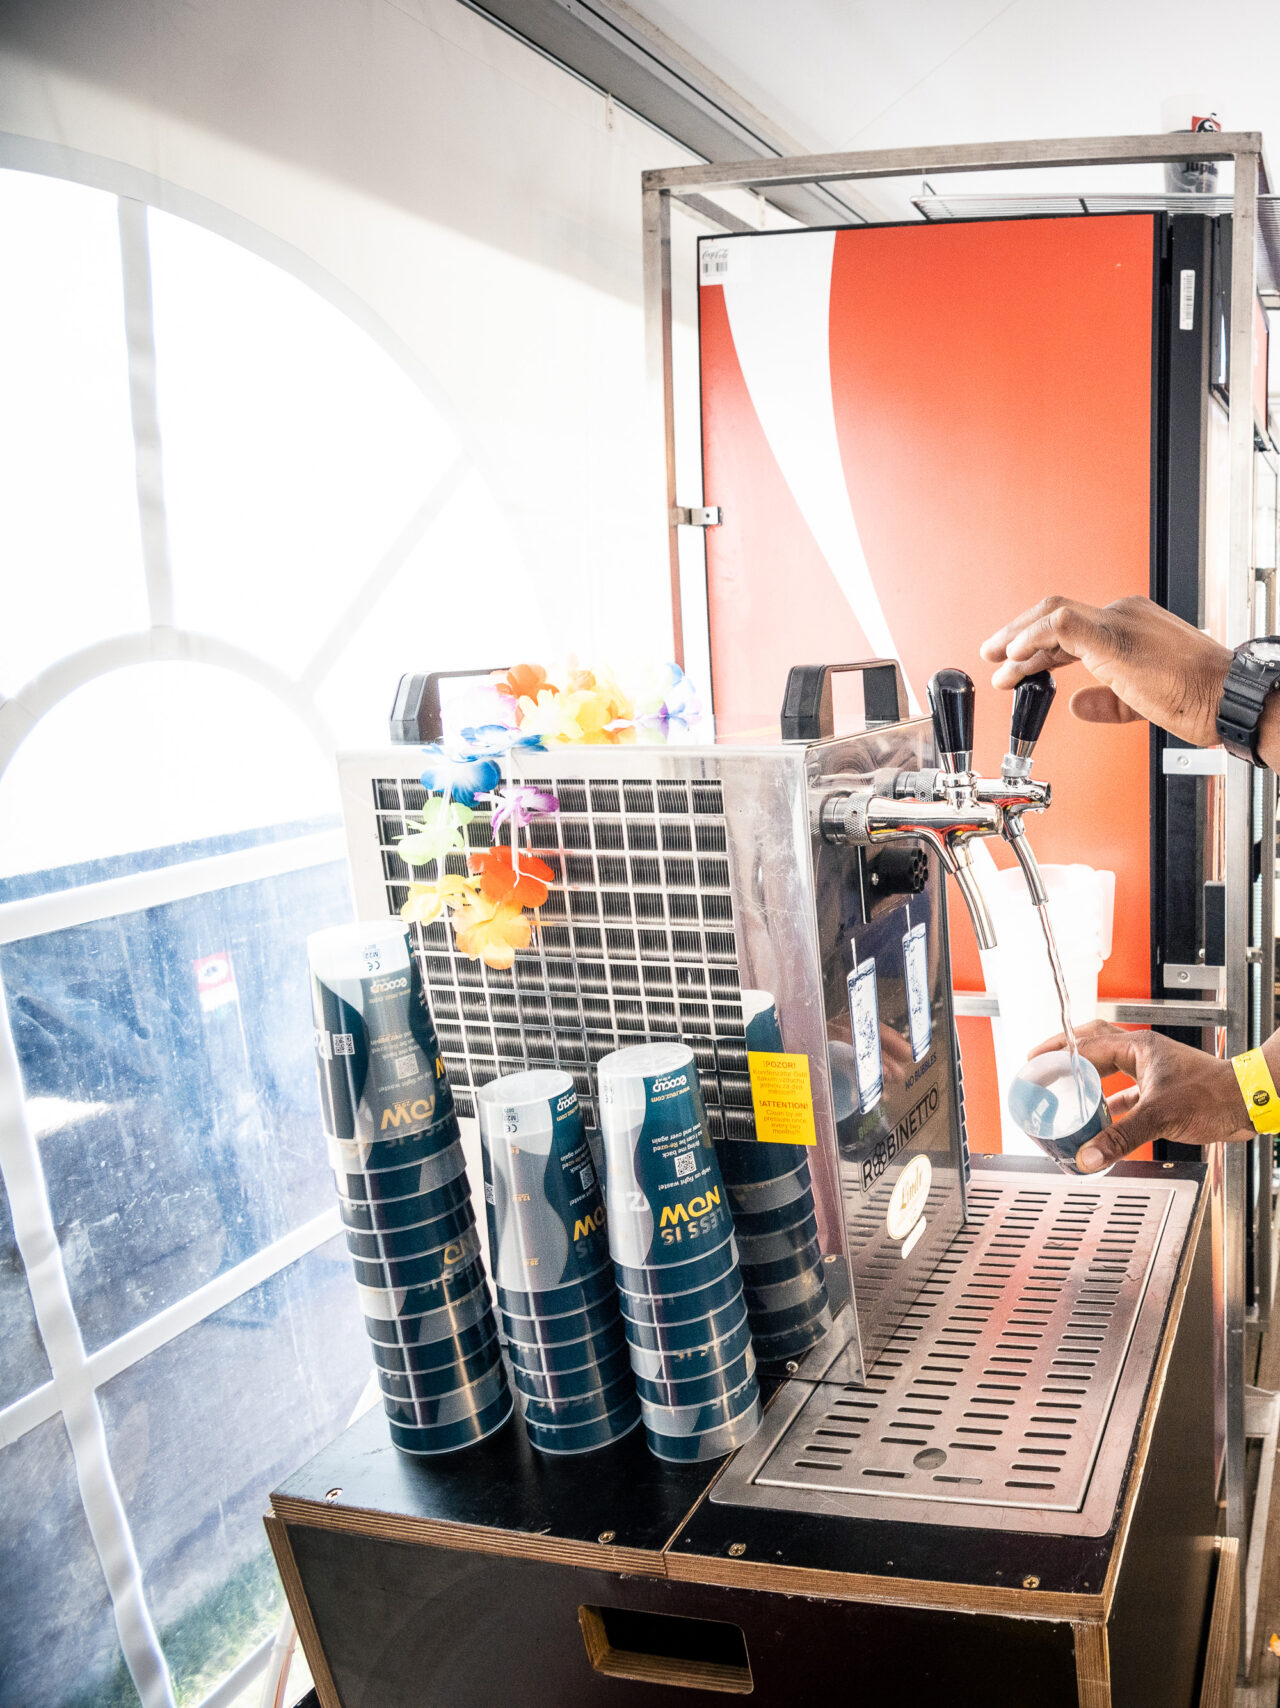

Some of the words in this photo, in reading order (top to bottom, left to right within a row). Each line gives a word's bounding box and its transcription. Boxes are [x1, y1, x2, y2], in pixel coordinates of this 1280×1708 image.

[653, 1074, 687, 1093] ecocup
[759, 1100, 808, 1110] !ATTENTION!
[662, 1150, 677, 1159] back
[658, 1181, 679, 1191] waste!
[660, 1185, 720, 1227] NOW
[573, 1205, 605, 1242] OW
[661, 1227, 682, 1245] IS
